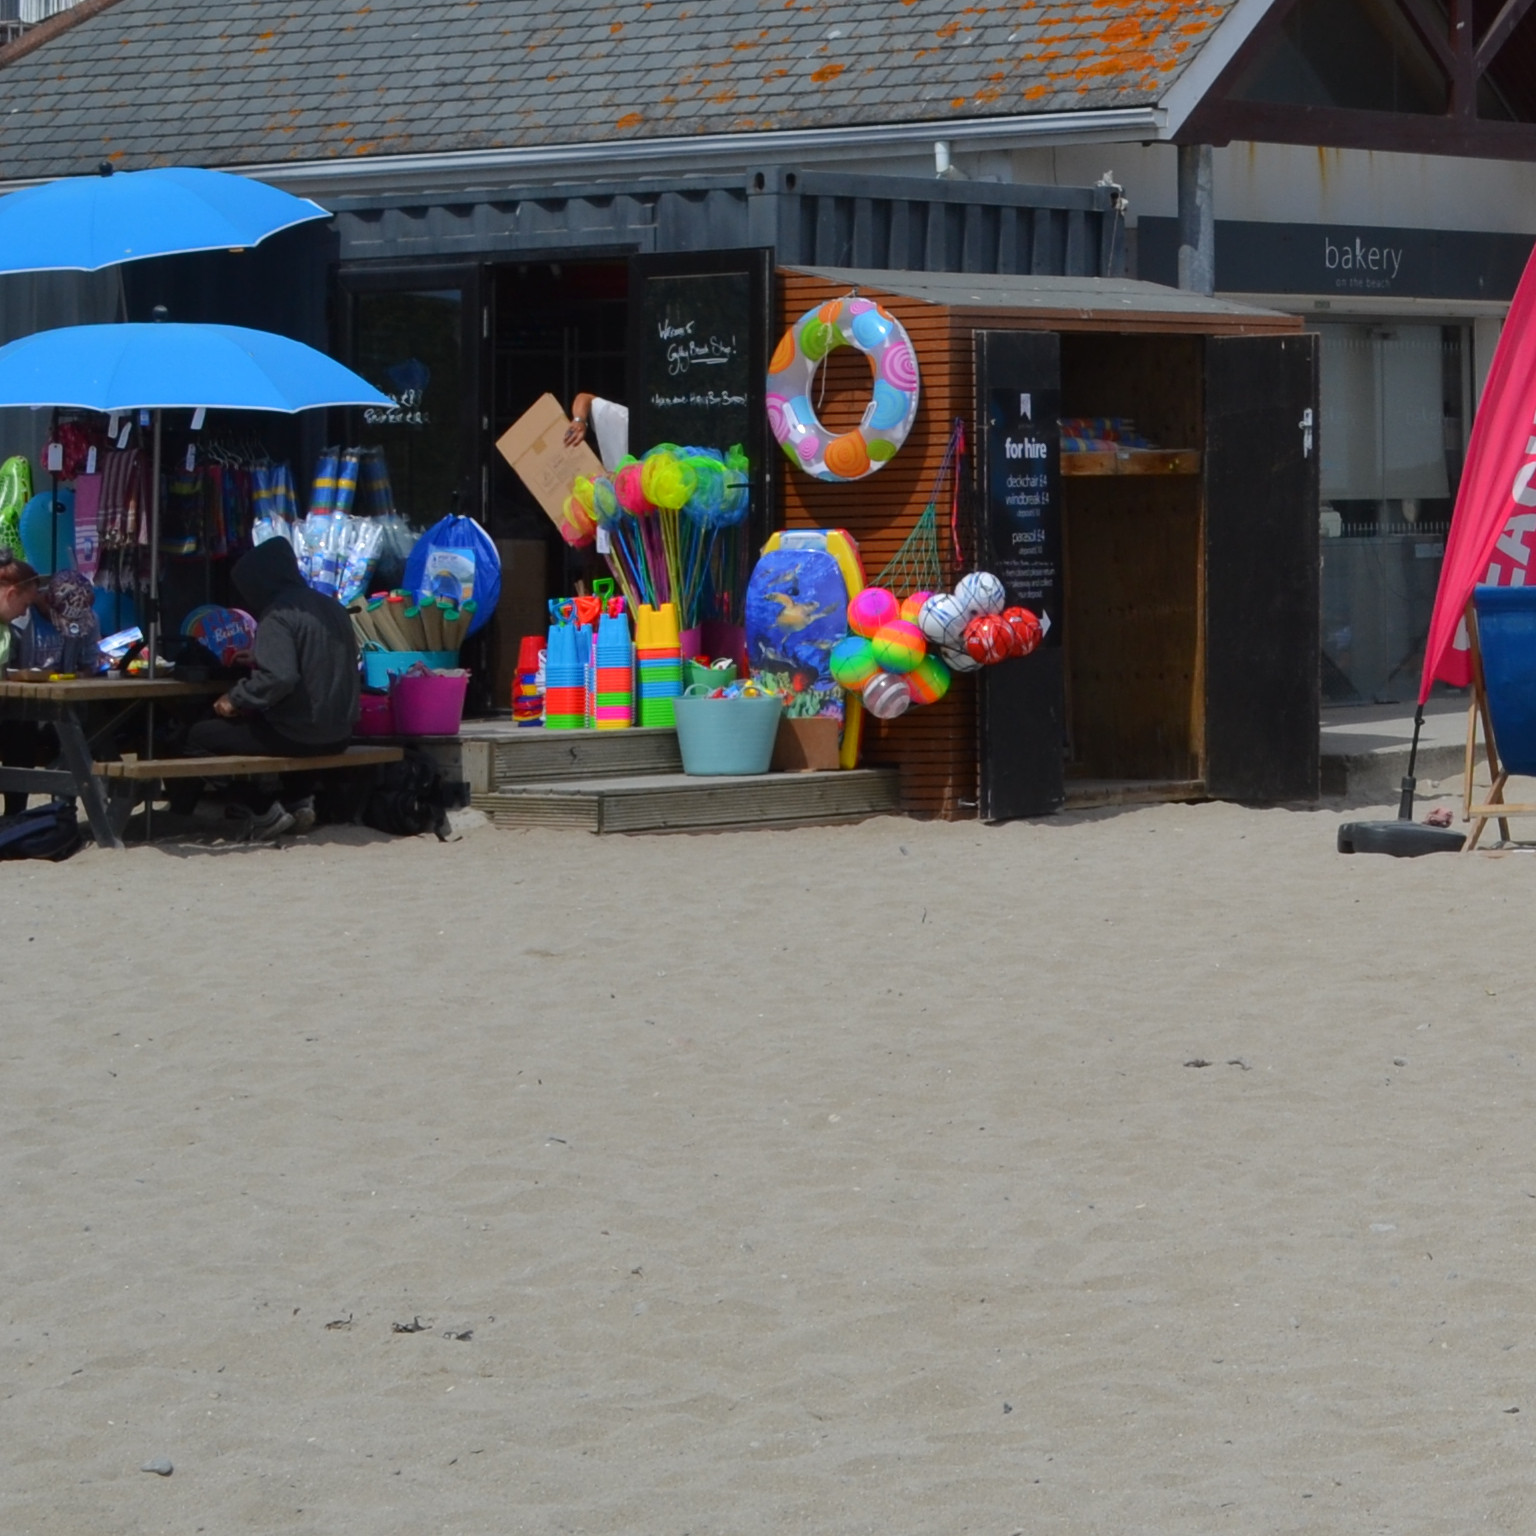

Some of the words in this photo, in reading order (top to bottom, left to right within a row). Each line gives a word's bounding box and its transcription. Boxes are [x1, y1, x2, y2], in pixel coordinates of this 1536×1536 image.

[1325, 237, 1403, 279] bakery
[1005, 437, 1023, 459] for
[1024, 437, 1047, 459] hire
